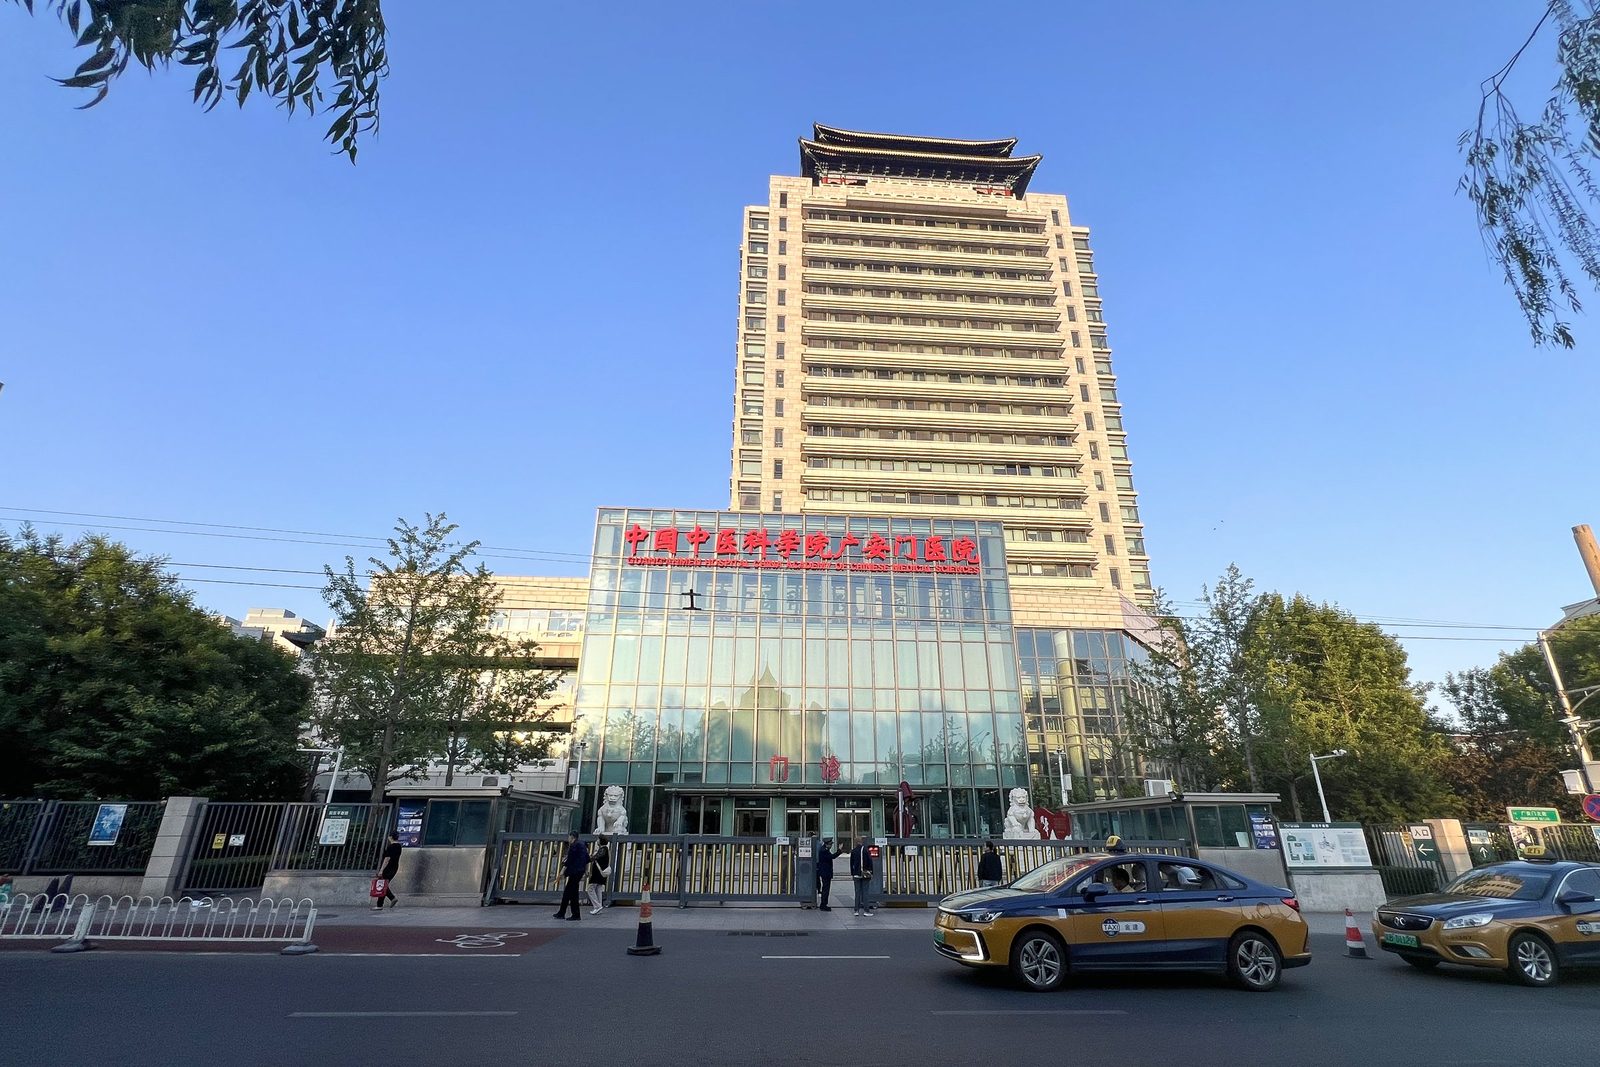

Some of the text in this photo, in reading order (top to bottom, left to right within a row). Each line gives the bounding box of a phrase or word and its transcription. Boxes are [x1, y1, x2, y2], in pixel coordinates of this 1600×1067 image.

[624, 523, 980, 564] 中国中医科学院广安门医院
[850, 562, 889, 572] CHINESE
[892, 563, 932, 573] MEDICAL
[935, 564, 980, 574] SCIENCES
[769, 755, 841, 782] 门诊
